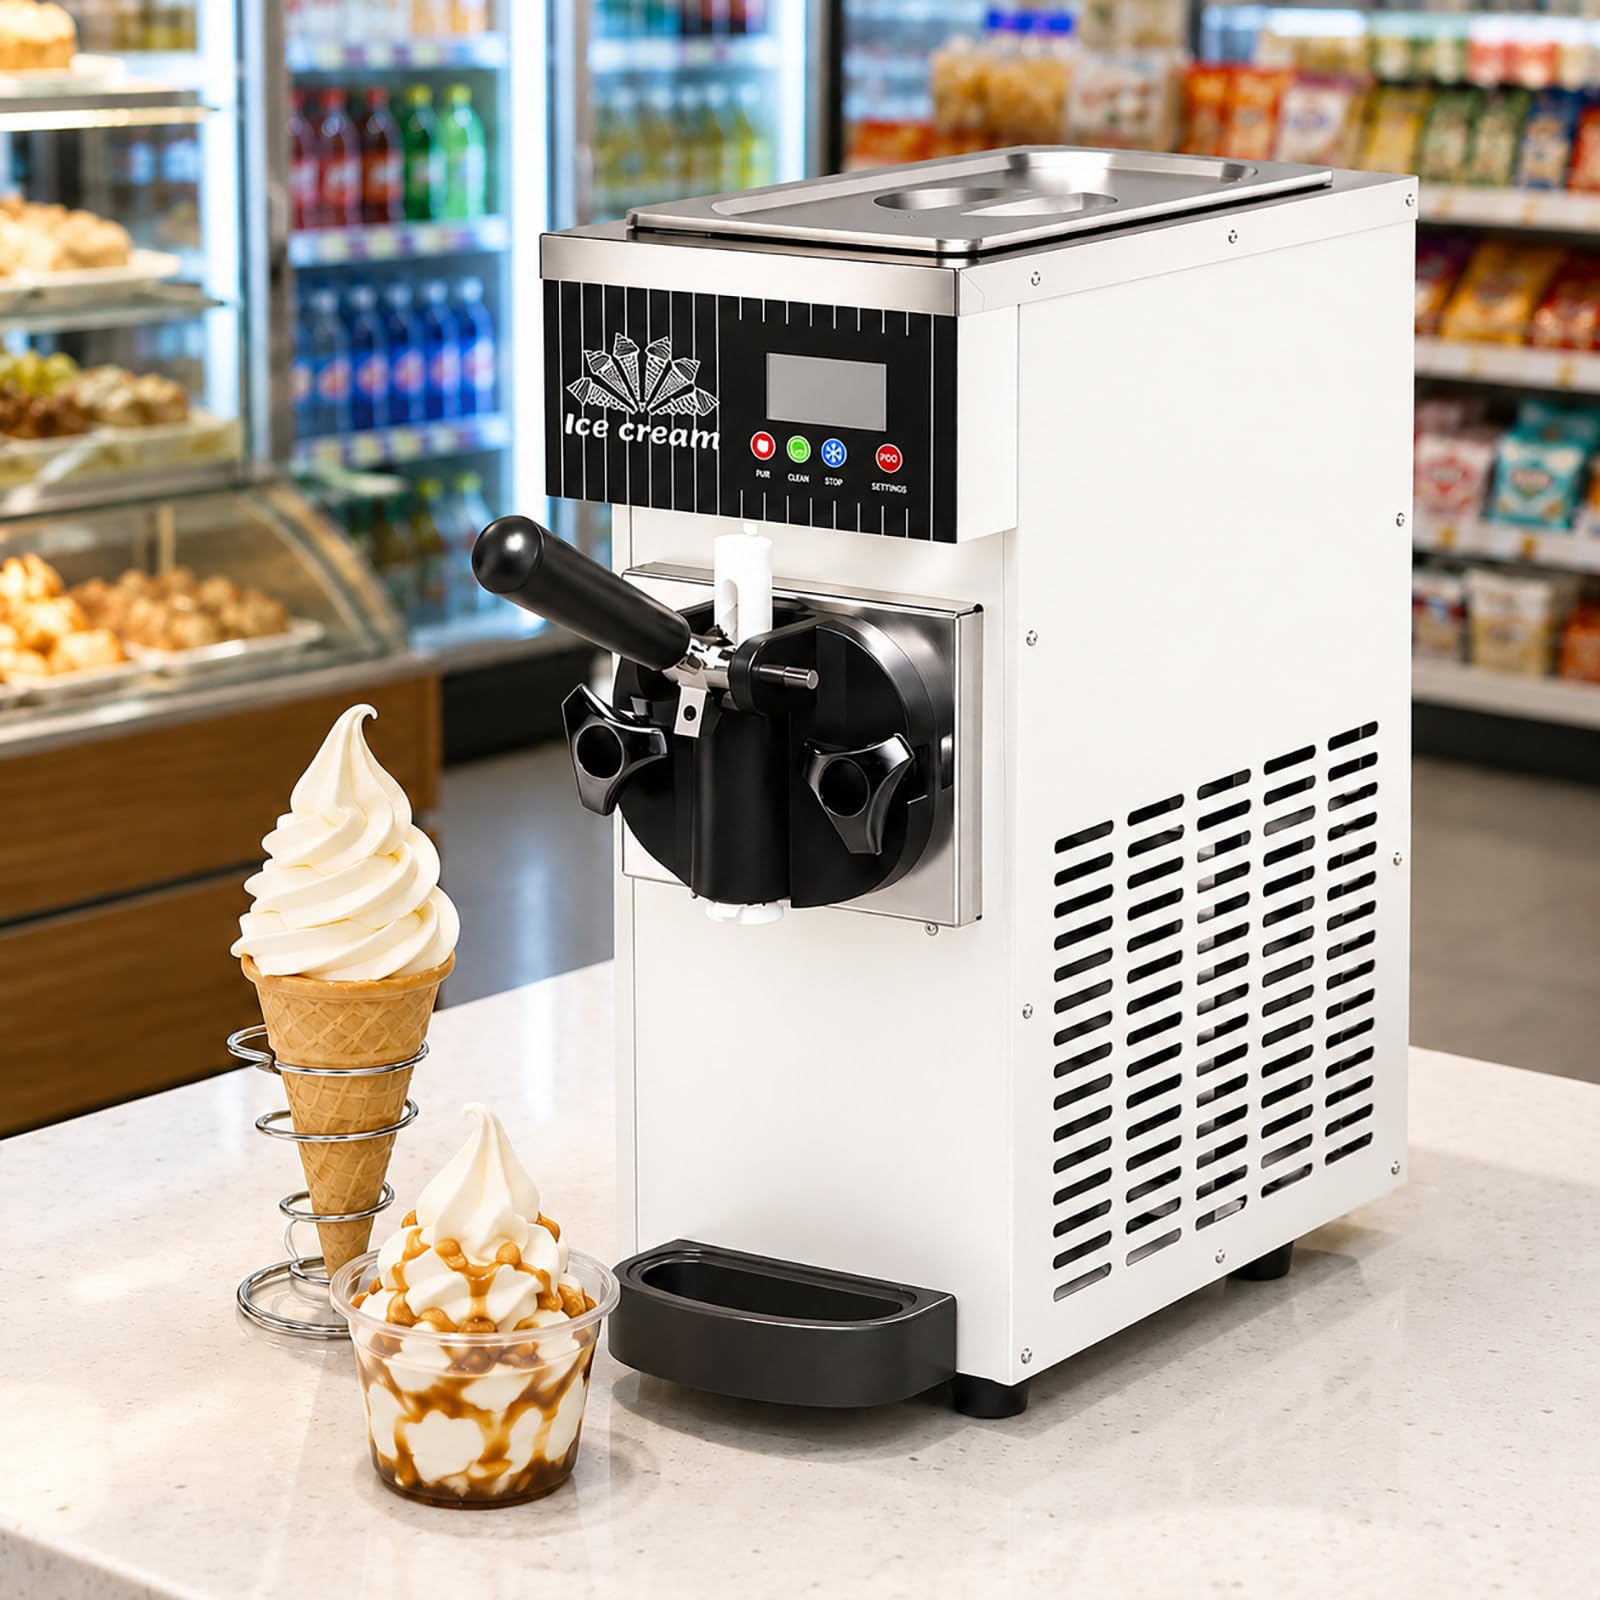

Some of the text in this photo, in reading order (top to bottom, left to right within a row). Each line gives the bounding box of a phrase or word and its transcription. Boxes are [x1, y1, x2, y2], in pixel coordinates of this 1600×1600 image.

[565, 413, 721, 450] Ice cream
[787, 473, 810, 483] CLEAN
[824, 477, 844, 487] STOP
[871, 482, 908, 494] SETTINGS
